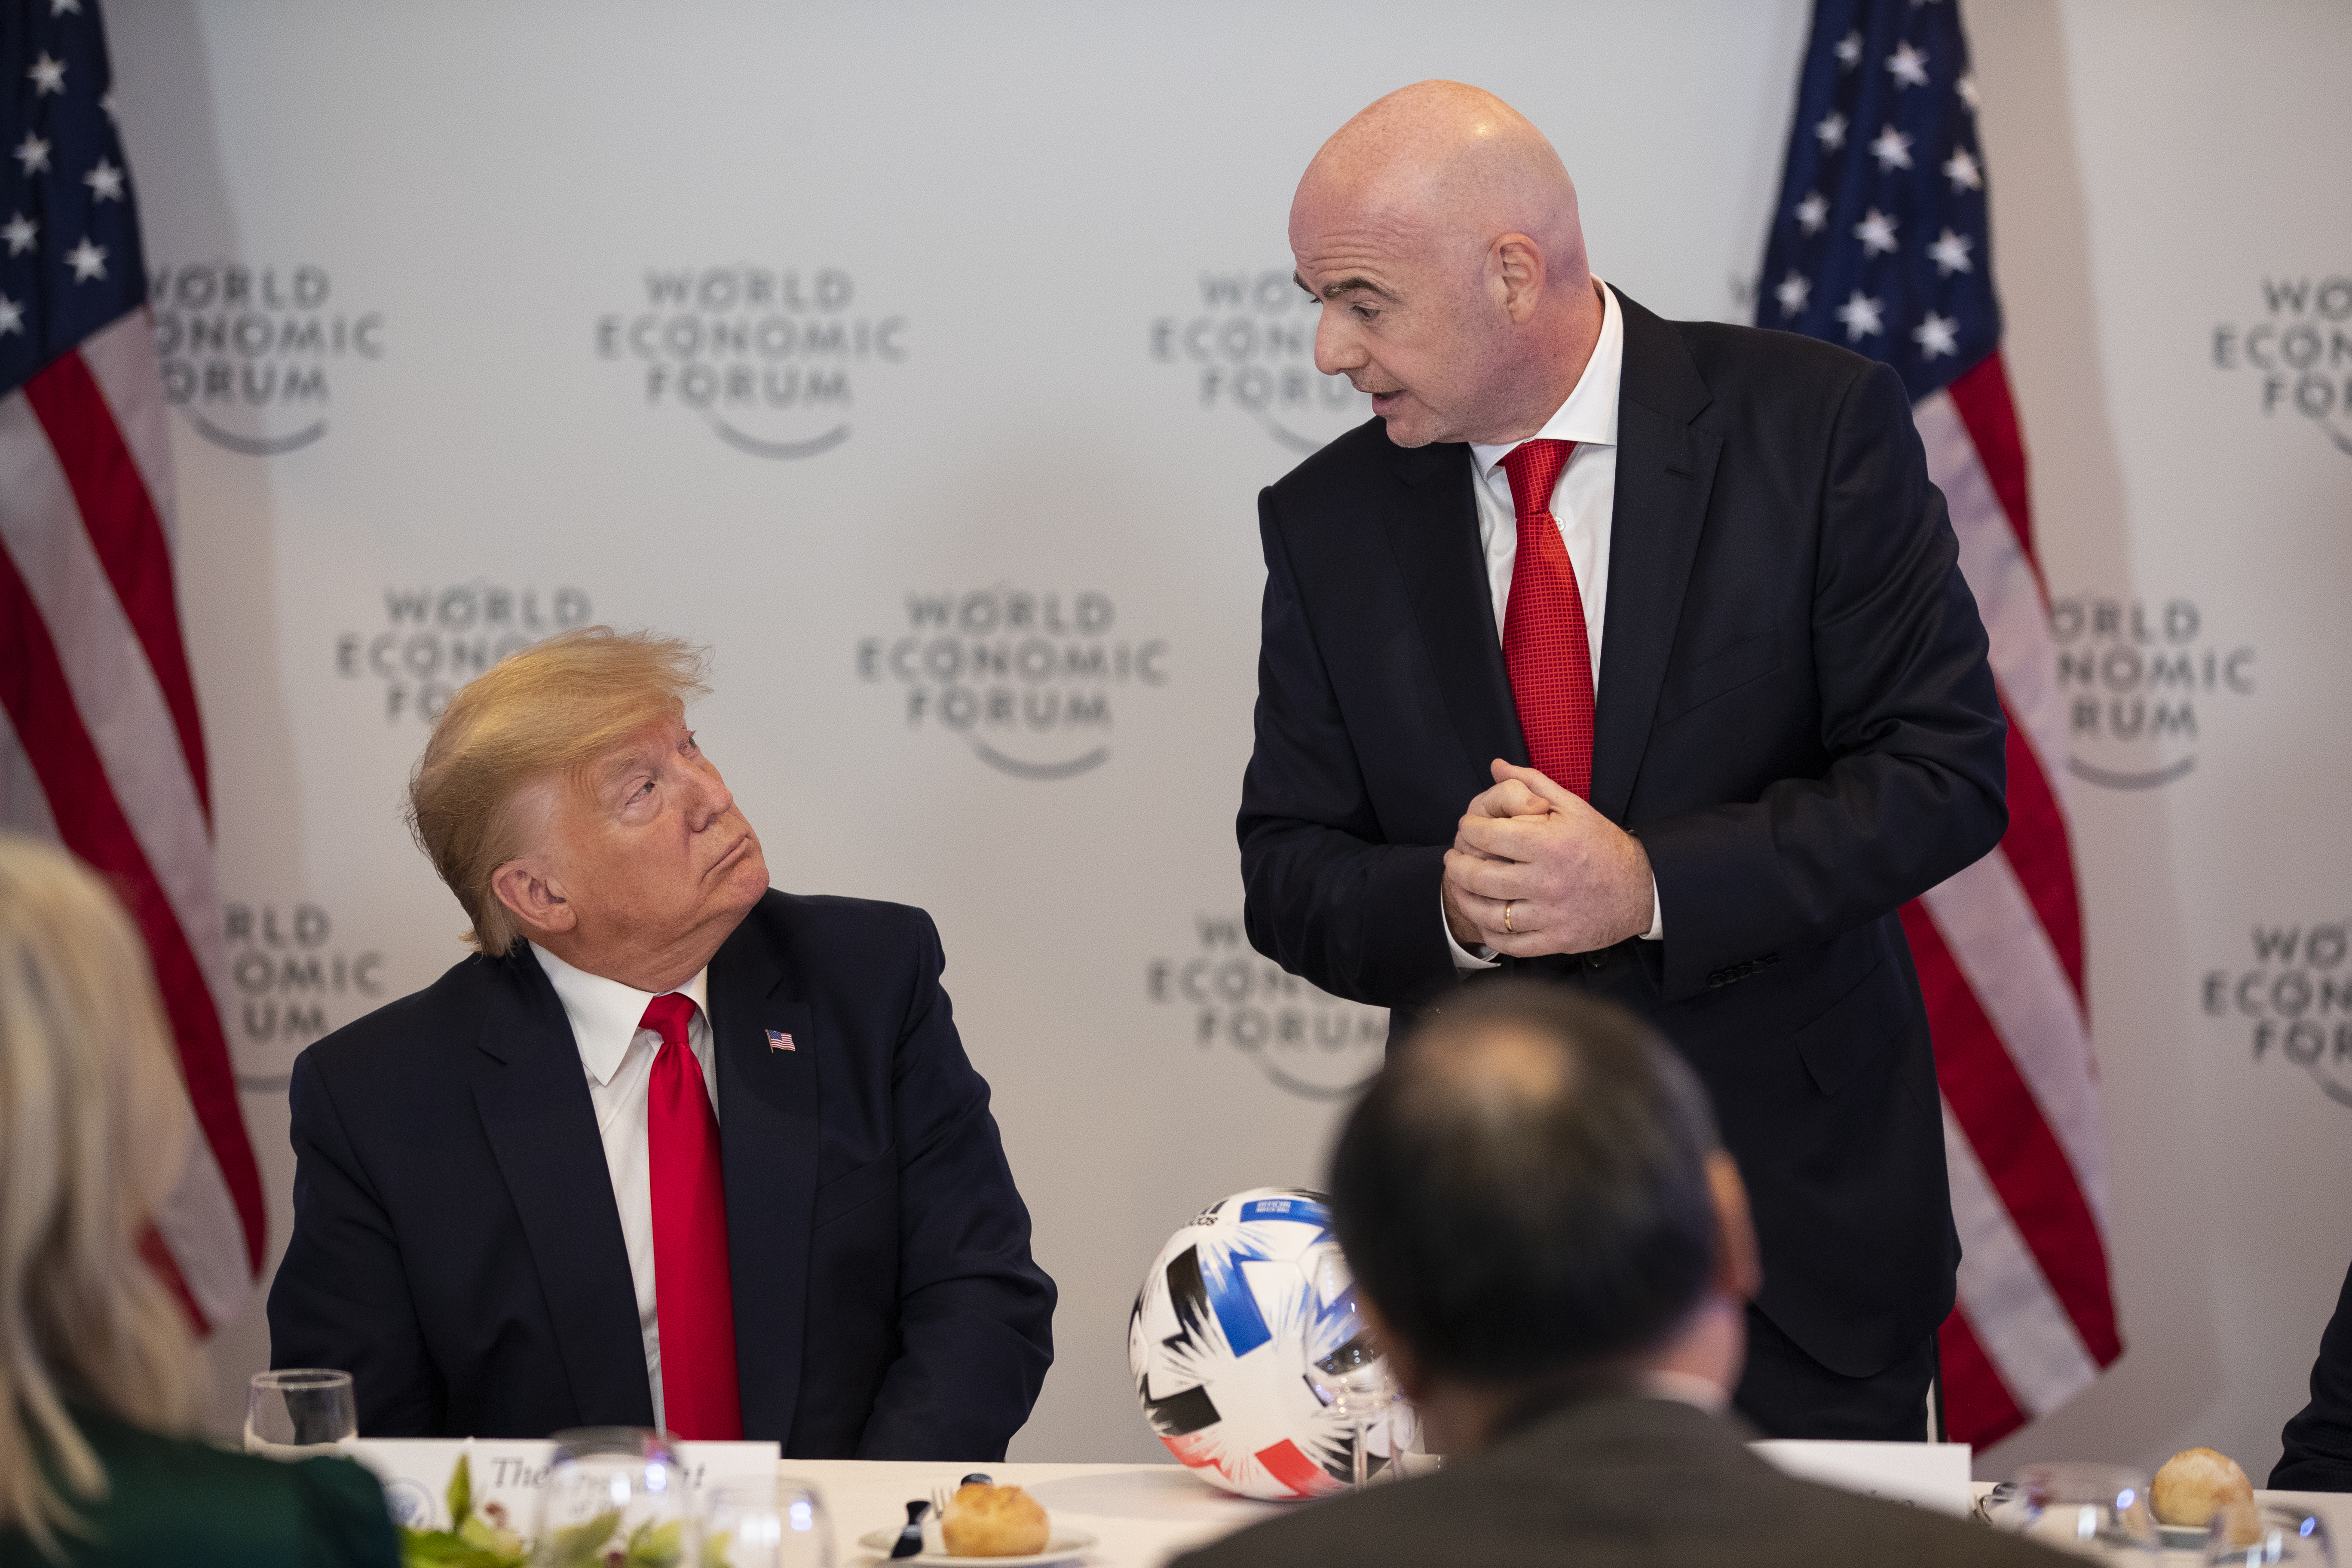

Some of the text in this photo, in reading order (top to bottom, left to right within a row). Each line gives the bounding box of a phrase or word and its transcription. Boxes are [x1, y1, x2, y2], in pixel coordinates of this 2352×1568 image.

[643, 265, 856, 315] WORLD
[153, 311, 385, 361] ONOMIC
[594, 312, 910, 365] ECONOMIC
[1150, 316, 1316, 365] ECON
[2211, 322, 2352, 371] ECON
[160, 358, 330, 407] ORUM
[644, 361, 856, 410] FORUM
[1201, 364, 1372, 413] FORU
[385, 584, 592, 633] WORLD
[904, 589, 1116, 638] WORLD
[2049, 599, 2201, 646] ORLD
[856, 637, 1169, 688] ECONOMIC
[2056, 646, 2257, 696] NOMIC
[906, 685, 1114, 733] FORUM
[2070, 693, 2199, 742] RUM
[224, 902, 332, 949] RLD
[233, 949, 386, 999] OMIC
[1145, 956, 1315, 1007] ECON
[2202, 968, 2352, 1019] ECON
